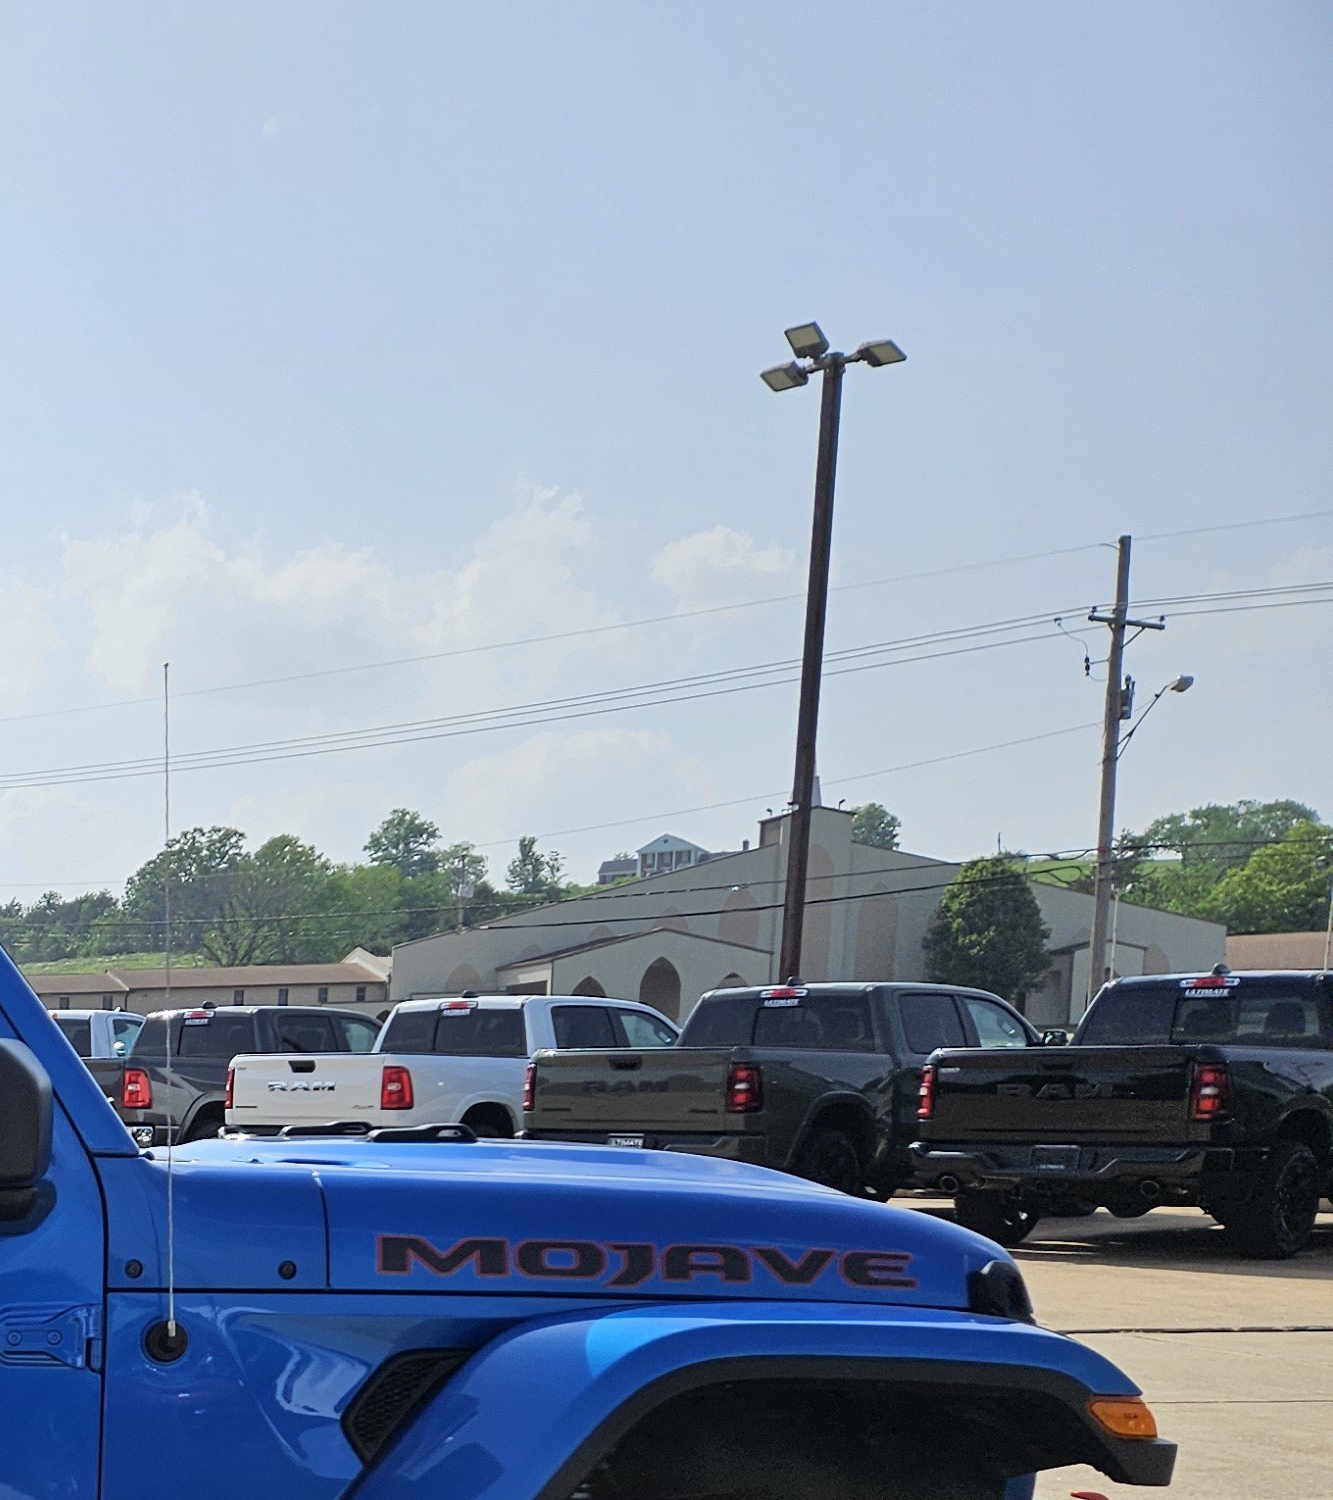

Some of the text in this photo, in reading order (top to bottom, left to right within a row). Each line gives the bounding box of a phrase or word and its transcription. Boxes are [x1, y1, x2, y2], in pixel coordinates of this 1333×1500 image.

[268, 1081, 336, 1092] RAM
[997, 1083, 1113, 1098] RAM
[376, 1234, 918, 1289] MOJAVE
